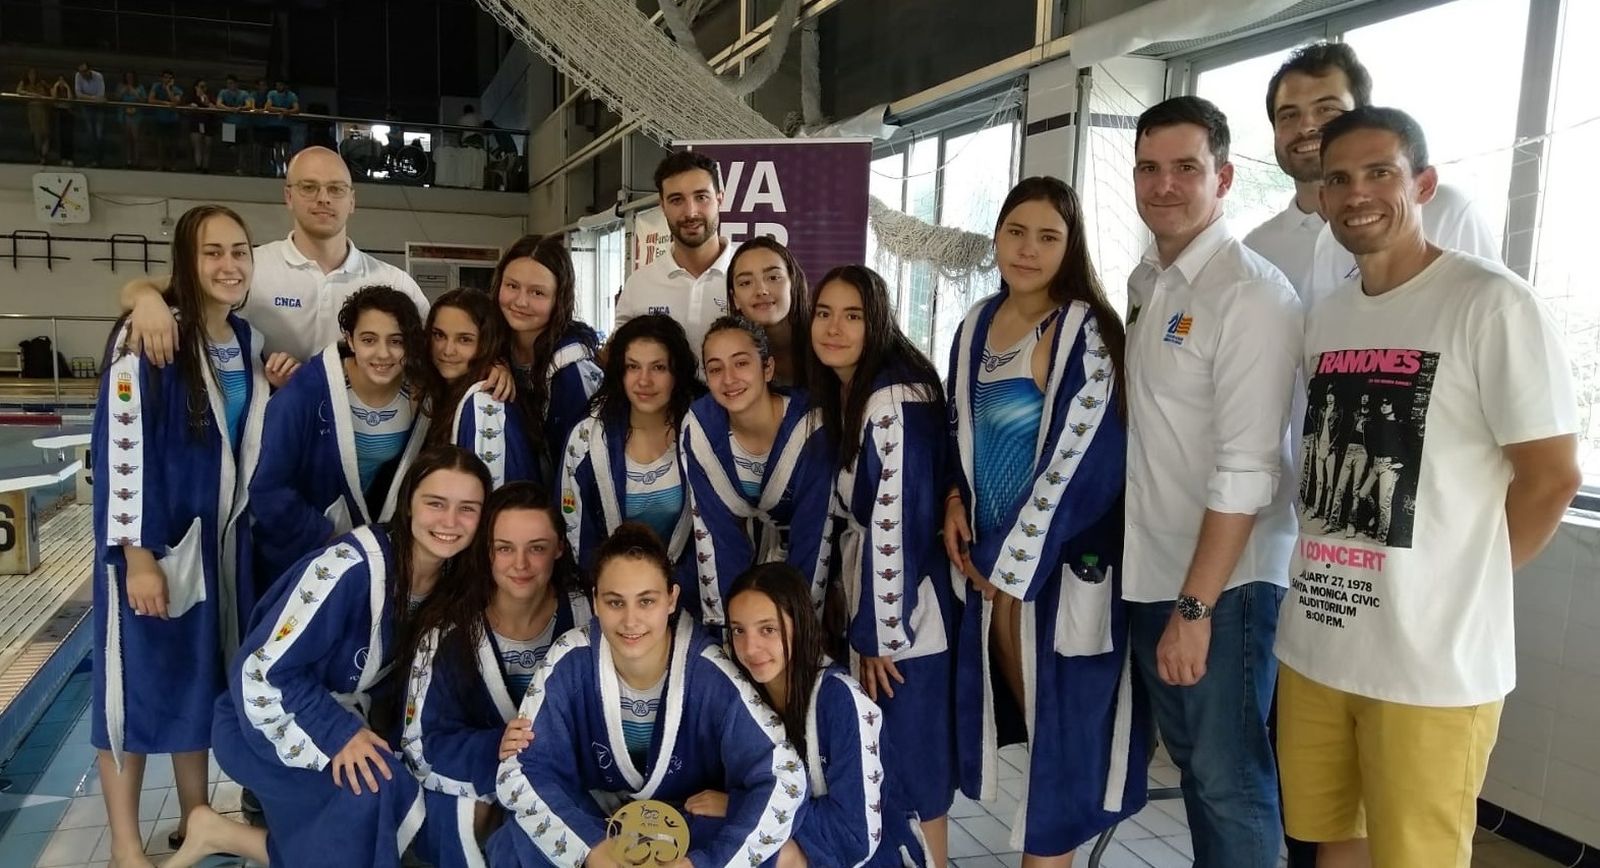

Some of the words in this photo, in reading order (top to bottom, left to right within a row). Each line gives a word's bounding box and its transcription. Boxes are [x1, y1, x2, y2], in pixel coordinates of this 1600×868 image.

[274, 296, 302, 308] CNCA
[1318, 349, 1422, 375] RAMONES
[1306, 540, 1386, 572] CONCERT
[1330, 576, 1345, 589] 27,
[1346, 579, 1373, 593] 1978
[1299, 595, 1357, 617] AUDITORIUM
[1310, 585, 1348, 603] MONICA
[1351, 593, 1381, 608] CIVIC
[1305, 609, 1325, 624] 8:00
